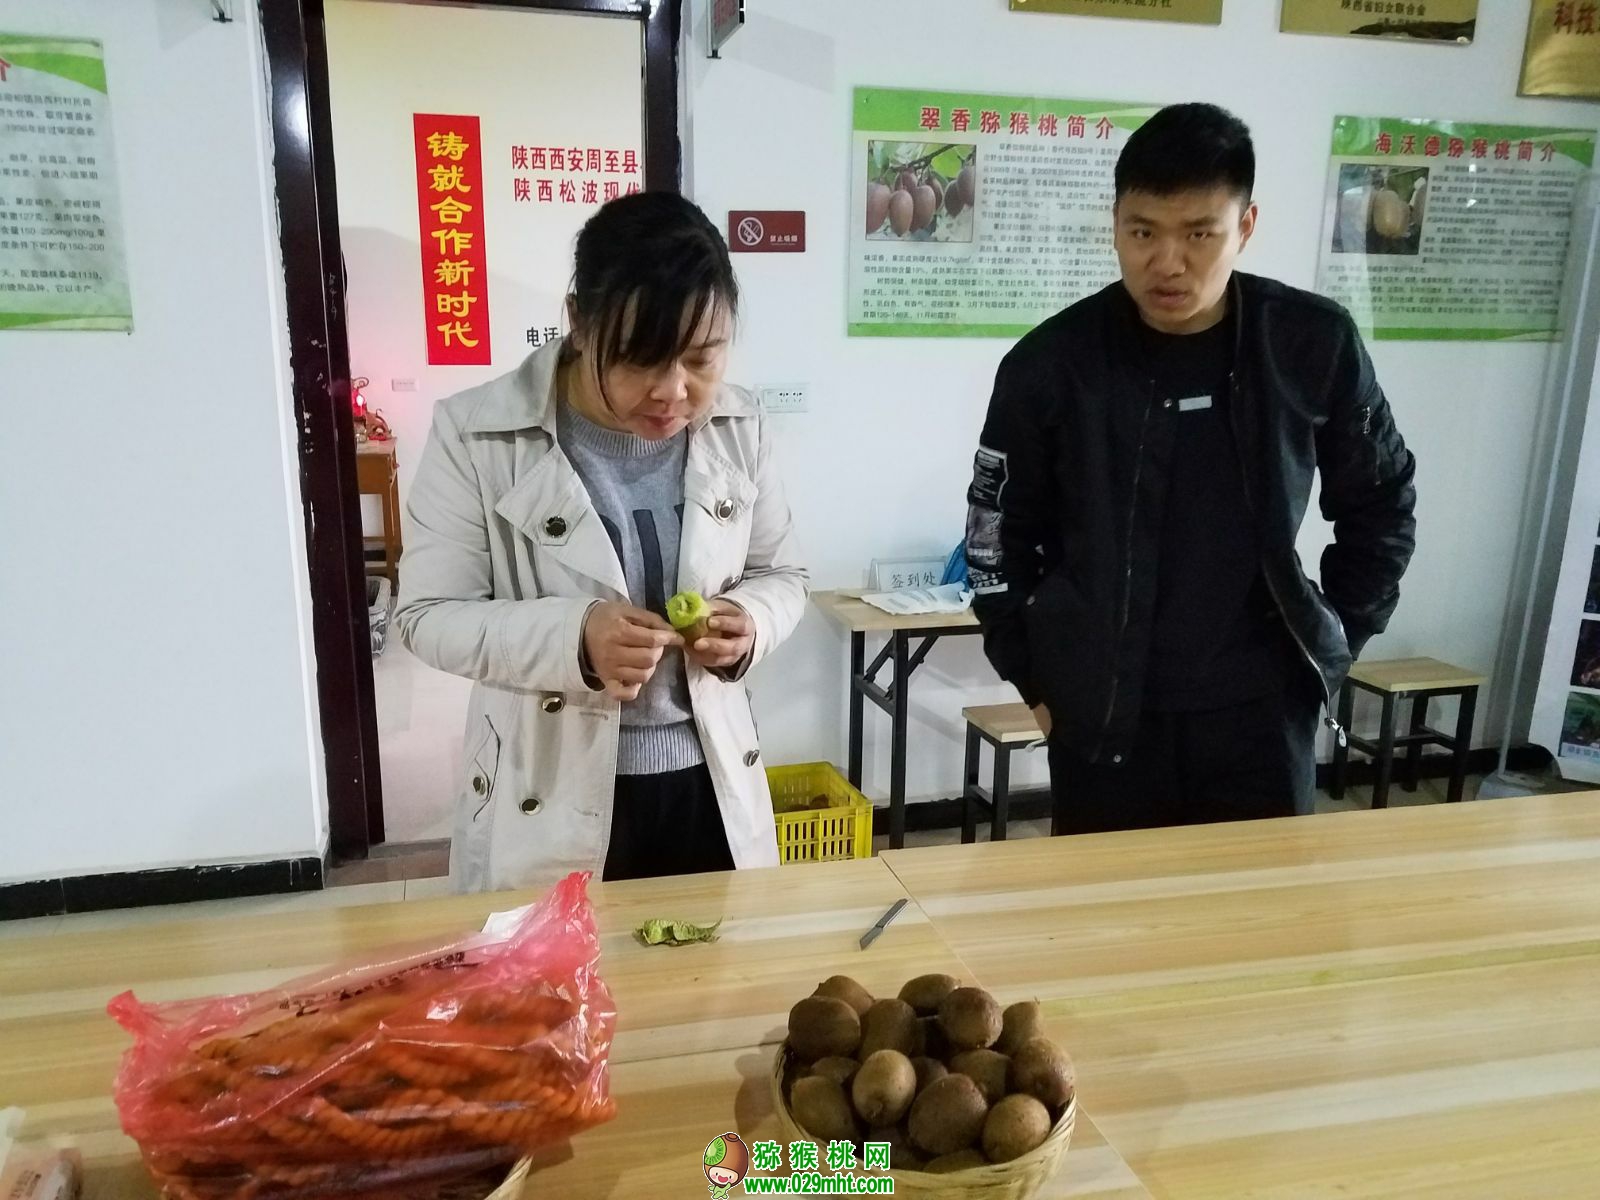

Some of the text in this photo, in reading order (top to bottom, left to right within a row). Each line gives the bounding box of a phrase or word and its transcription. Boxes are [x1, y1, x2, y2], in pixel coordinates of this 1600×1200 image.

[1554, 1, 1600, 37] 科技
[919, 106, 1115, 140] 翠香猕猴桃简介
[511, 145, 642, 175] 陕西西安周至县
[1375, 133, 1557, 163] 海沃德猕猴桃简介
[426, 131, 479, 348] 铸就合作新时代
[527, 326, 559, 348] 电话
[891, 571, 937, 588] 签到处
